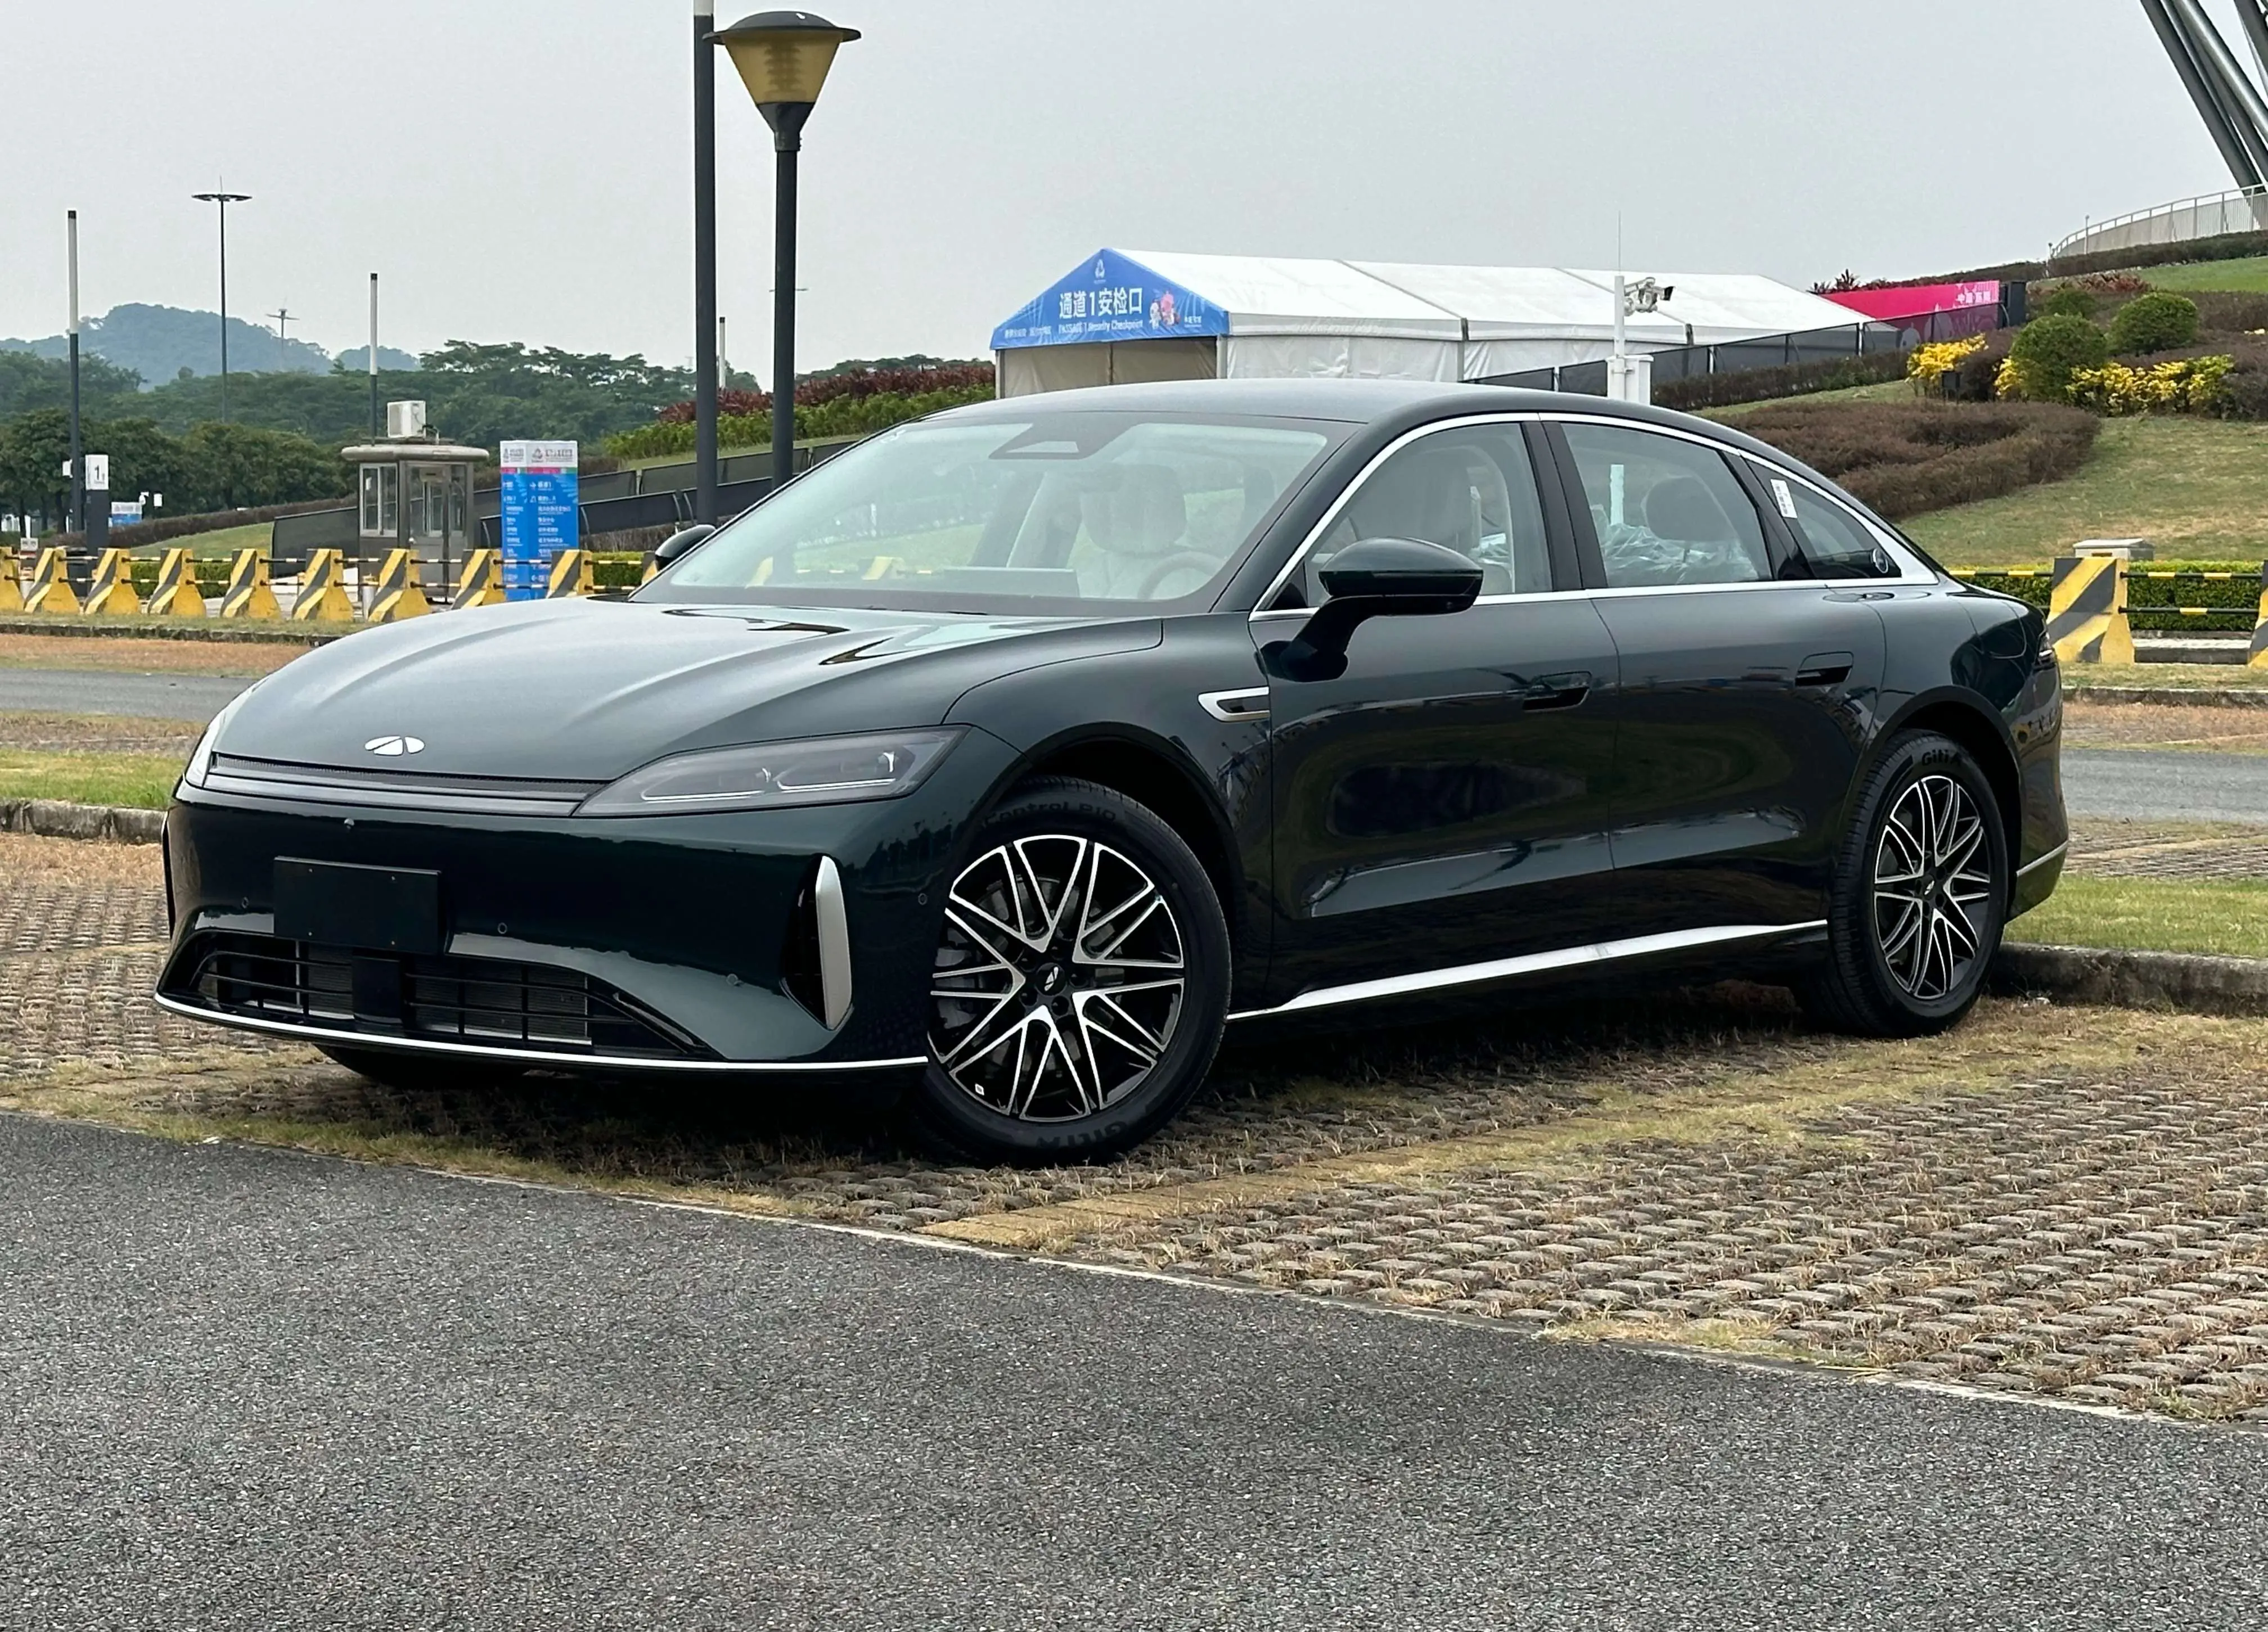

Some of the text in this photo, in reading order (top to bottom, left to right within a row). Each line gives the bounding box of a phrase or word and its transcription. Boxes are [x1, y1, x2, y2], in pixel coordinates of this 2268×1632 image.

[1059, 287, 1142, 319] 通道1安检口
